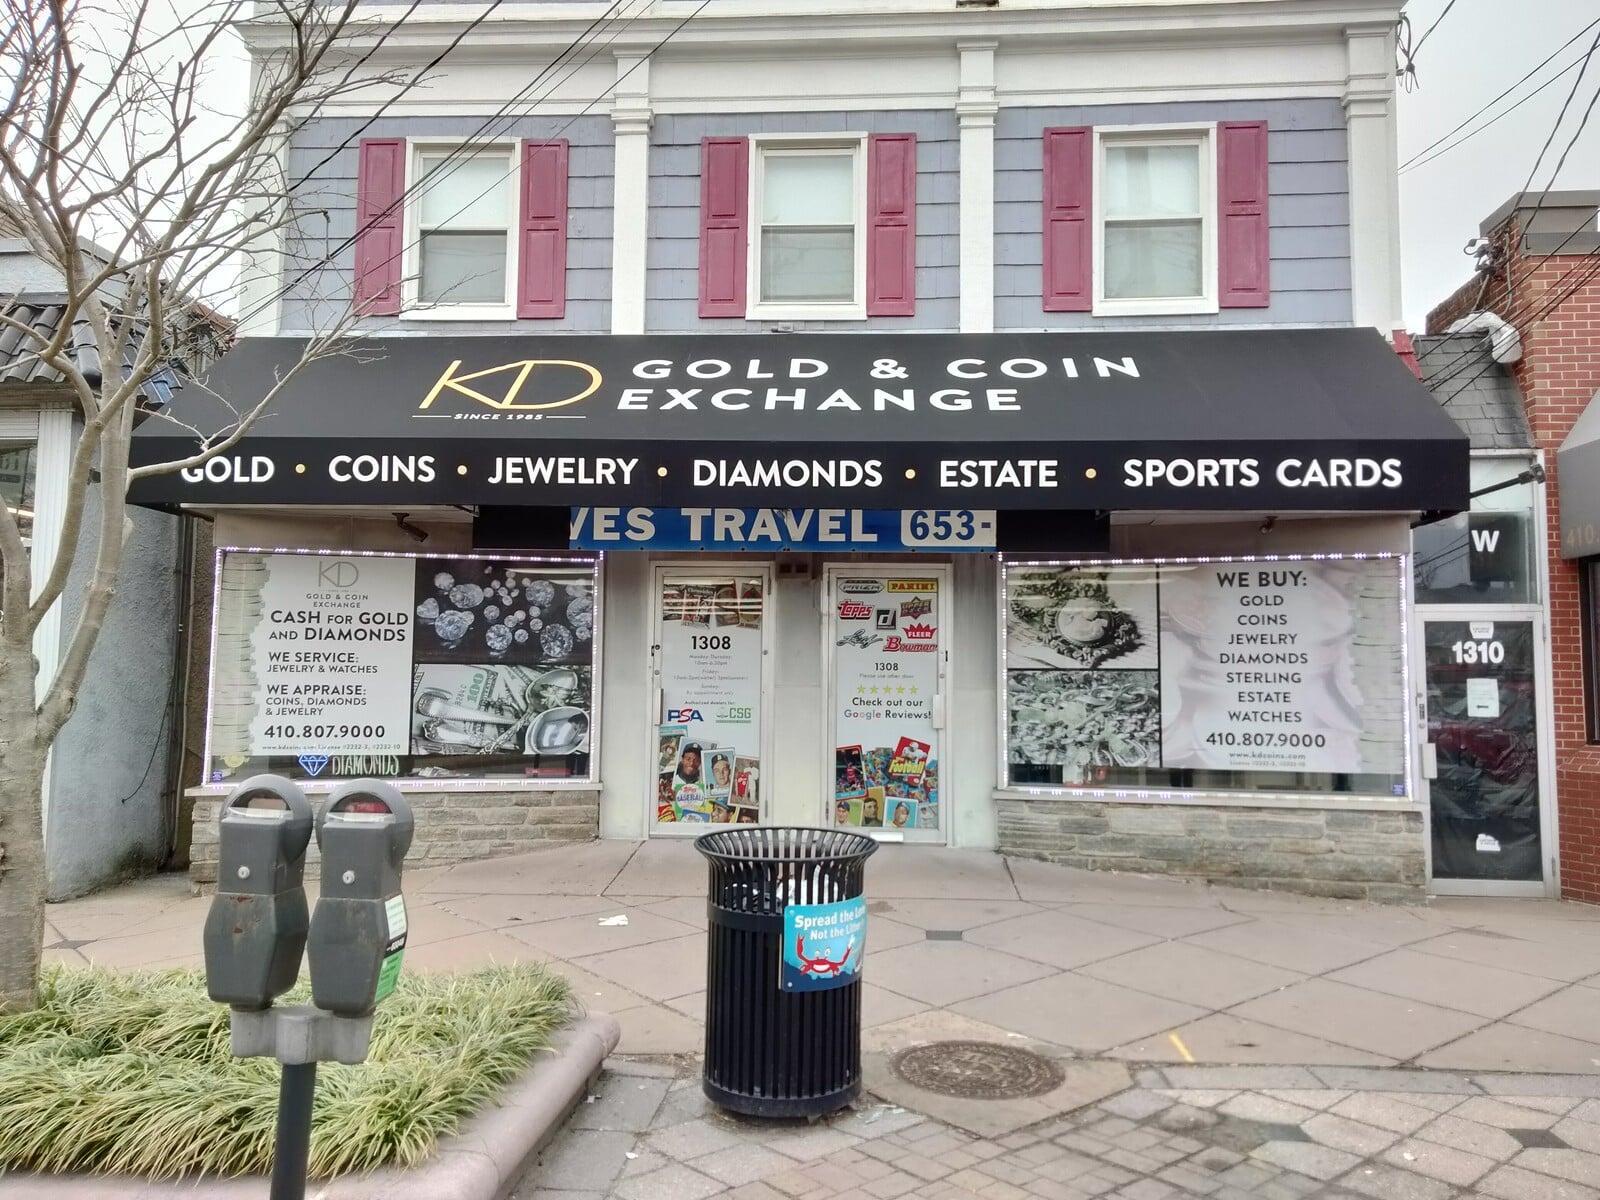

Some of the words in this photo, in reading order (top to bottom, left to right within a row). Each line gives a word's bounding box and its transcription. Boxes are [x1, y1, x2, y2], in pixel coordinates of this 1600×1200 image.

[632, 358, 829, 379] GOLD
[869, 358, 909, 379] &
[946, 357, 1141, 379] COIN
[418, 359, 602, 409] KD
[616, 388, 1022, 411] EXCHANGE
[180, 455, 275, 483] GOLD
[328, 455, 436, 482] COINS
[487, 457, 639, 485] JEWELRY
[693, 459, 883, 488] DIAMONDS
[940, 459, 1058, 488] ESTATE
[1123, 458, 1260, 488] SPORTS
[1275, 458, 1403, 488] CARDS
[681, 508, 878, 542] TRAVEL
[910, 510, 992, 541] 653-
[1471, 530, 1500, 553] W
[318, 560, 360, 588] KD
[1216, 572, 1250, 587] WE
[1258, 571, 1307, 587] BUY:
[313, 601, 361, 609] EXCHANGE
[1240, 595, 1284, 606] GOLD
[270, 610, 321, 624] CASH
[327, 615, 352, 625] FOR
[358, 612, 409, 626] GOLD
[1237, 614, 1288, 626] COINS
[269, 630, 298, 641] AND
[304, 627, 406, 642] DIAMONDS
[1228, 633, 1298, 645] JEWELRY
[691, 635, 732, 650] 1308
[268, 651, 290, 663] WE
[294, 652, 359, 664] SERVICE:
[1219, 653, 1308, 664] DIAMONDS
[1452, 641, 1504, 664] 1310
[266, 664, 315, 674] JEWELRY
[318, 665, 326, 674] &
[328, 665, 378, 674] WATCHES
[875, 662, 899, 671] 1308
[1226, 672, 1302, 683] STERLING
[267, 684, 289, 695] WE
[292, 685, 367, 697] APPRAISE:
[1238, 691, 1291, 703] ESTATE
[265, 697, 304, 706] COINS,
[307, 697, 367, 706] DIAMONDS
[852, 697, 883, 706] Check
[886, 699, 903, 707] out
[906, 699, 924, 707] our
[265, 707, 273, 716] &
[275, 708, 323, 716] JEWELRY
[667, 708, 704, 723] PSA
[729, 707, 752, 719] CSG
[844, 709, 881, 720] Google
[885, 710, 932, 719] Reviews!
[1228, 711, 1302, 722] WATCHES
[264, 725, 386, 739] 410.807.9000
[1206, 732, 1326, 747] 410.807.9000
[794, 913, 838, 930] Spread
[840, 910, 855, 924] the
[810, 930, 828, 941] Not
[830, 928, 845, 938] the
